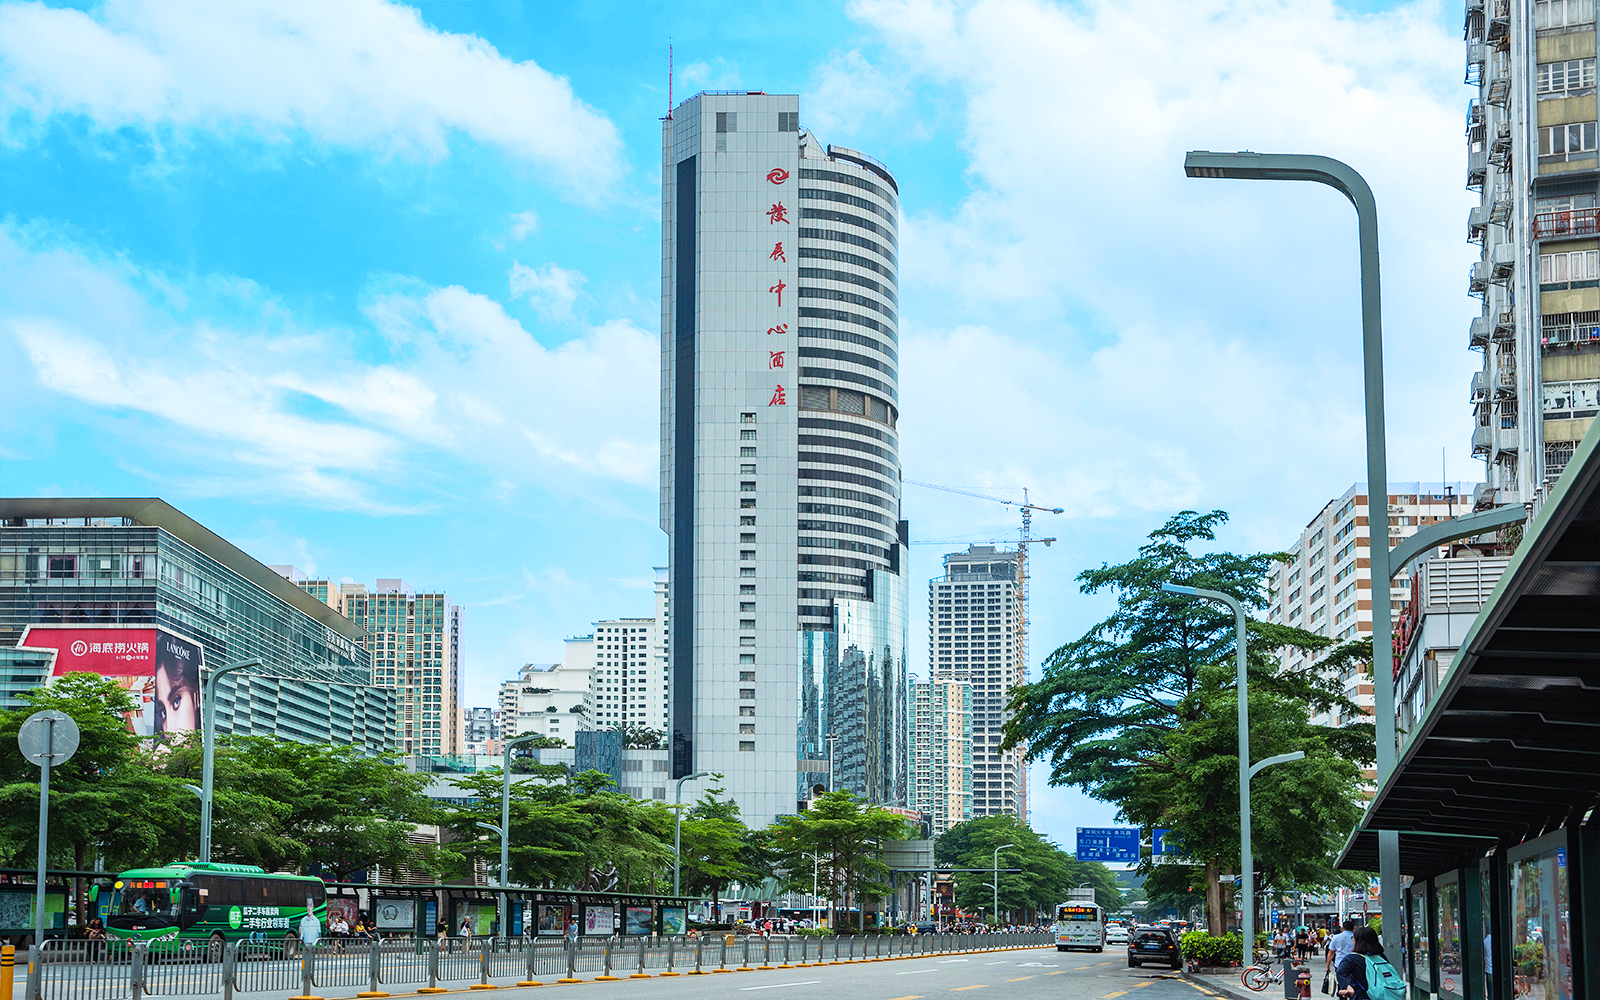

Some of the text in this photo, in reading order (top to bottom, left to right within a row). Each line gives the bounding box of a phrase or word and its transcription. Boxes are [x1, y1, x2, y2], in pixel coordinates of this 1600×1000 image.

[89, 642, 149, 653] 海底捞火锅
[243, 907, 279, 916] 瓜子二手车直卖网
